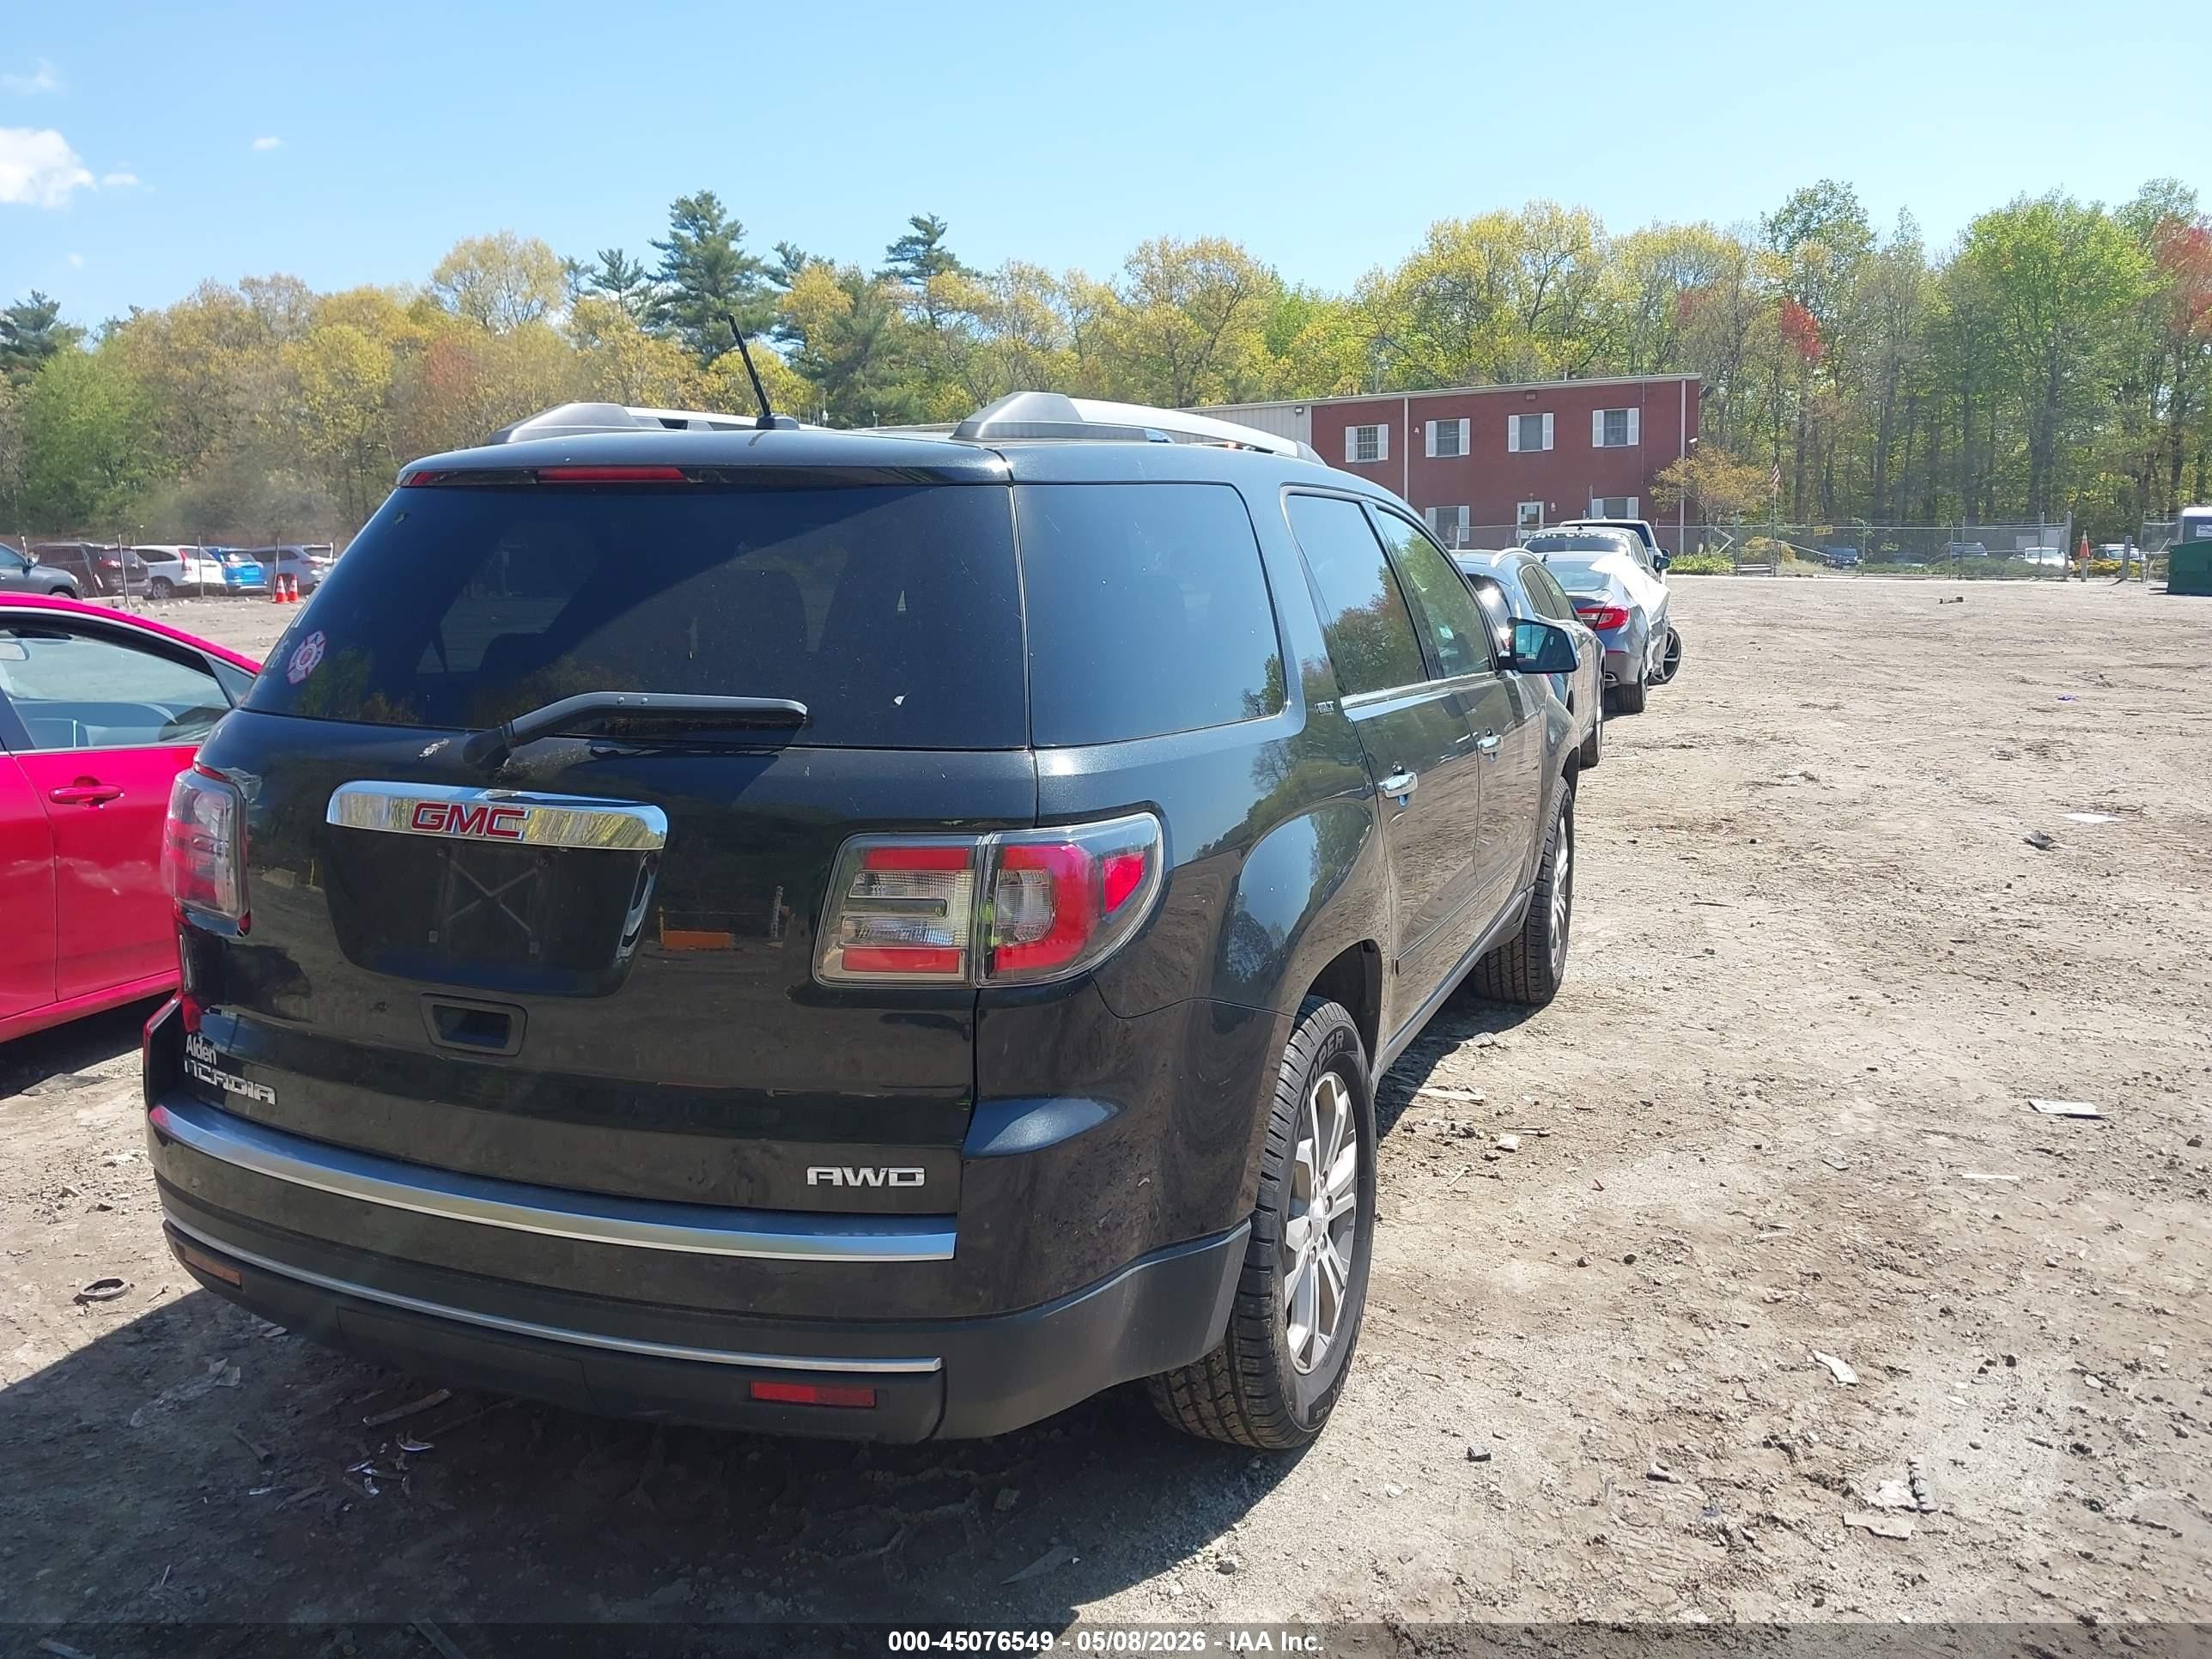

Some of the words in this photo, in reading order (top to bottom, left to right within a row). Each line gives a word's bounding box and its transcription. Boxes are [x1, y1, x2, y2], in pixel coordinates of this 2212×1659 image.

[411, 801, 530, 841] GMC
[185, 1033, 217, 1066] Alden
[184, 1059, 276, 1106] ACADIA
[806, 1165, 926, 1188] AWD
